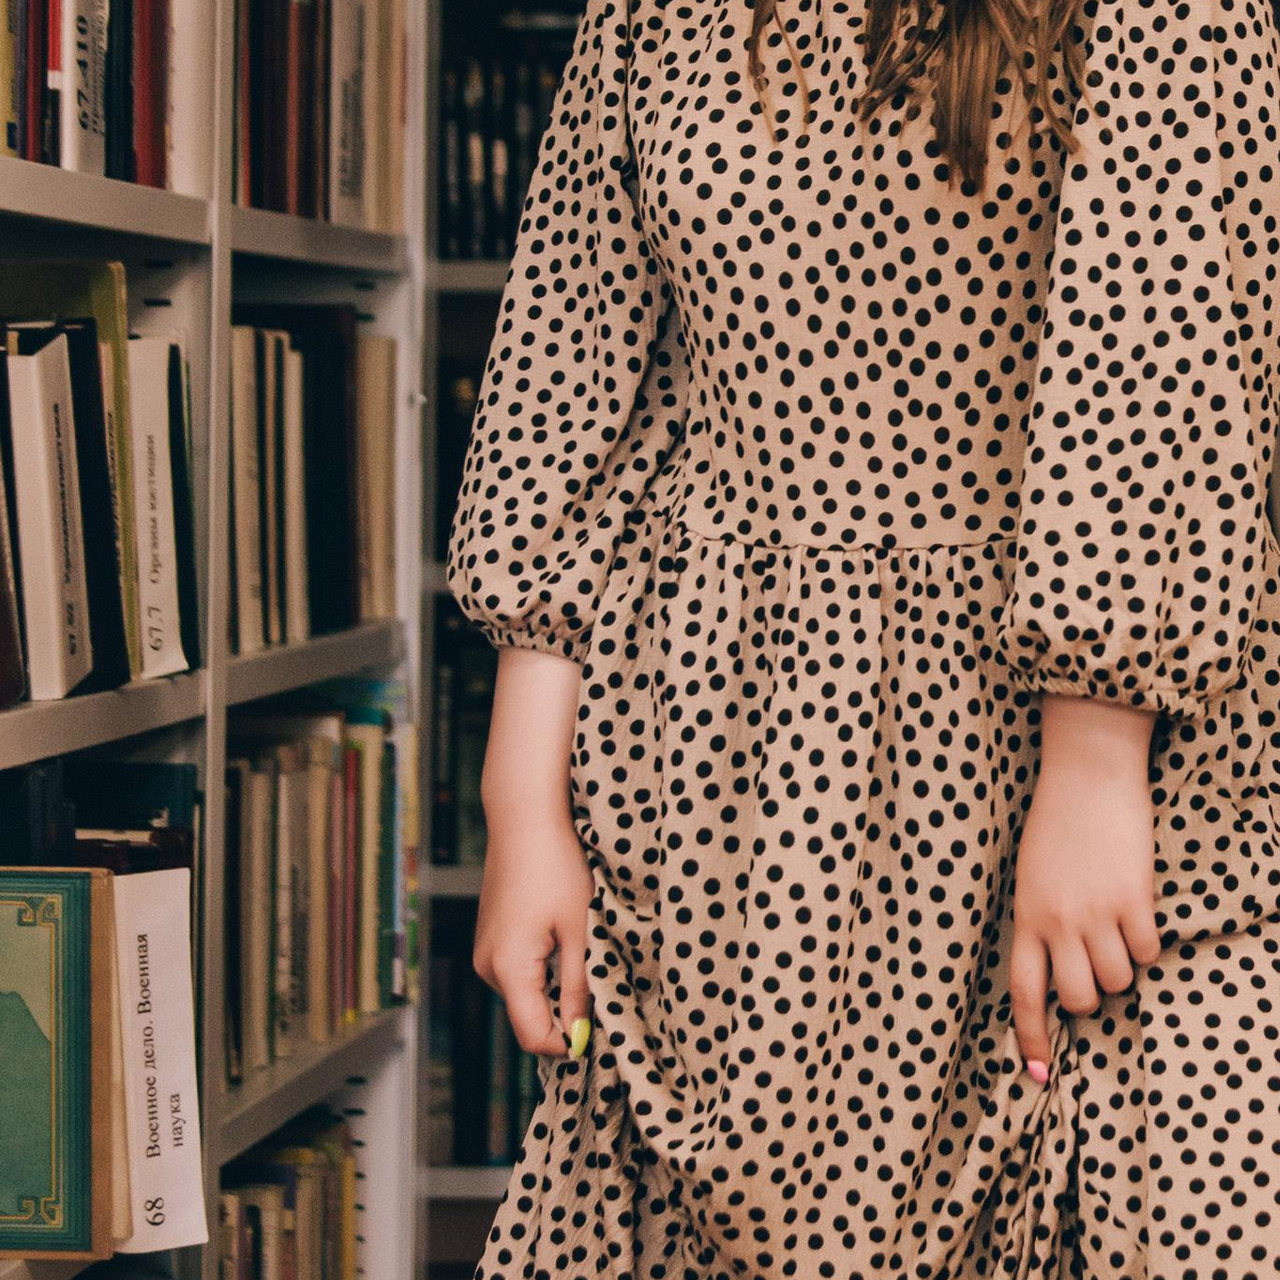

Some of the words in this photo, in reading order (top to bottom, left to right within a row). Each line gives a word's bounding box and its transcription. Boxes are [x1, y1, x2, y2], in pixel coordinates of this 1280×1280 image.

[138, 933, 152, 1015] Военная
[142, 1020, 156, 1069] дело.
[146, 1076, 161, 1158] Военное
[171, 1093, 186, 1148] наука
[145, 1196, 166, 1226] 68
